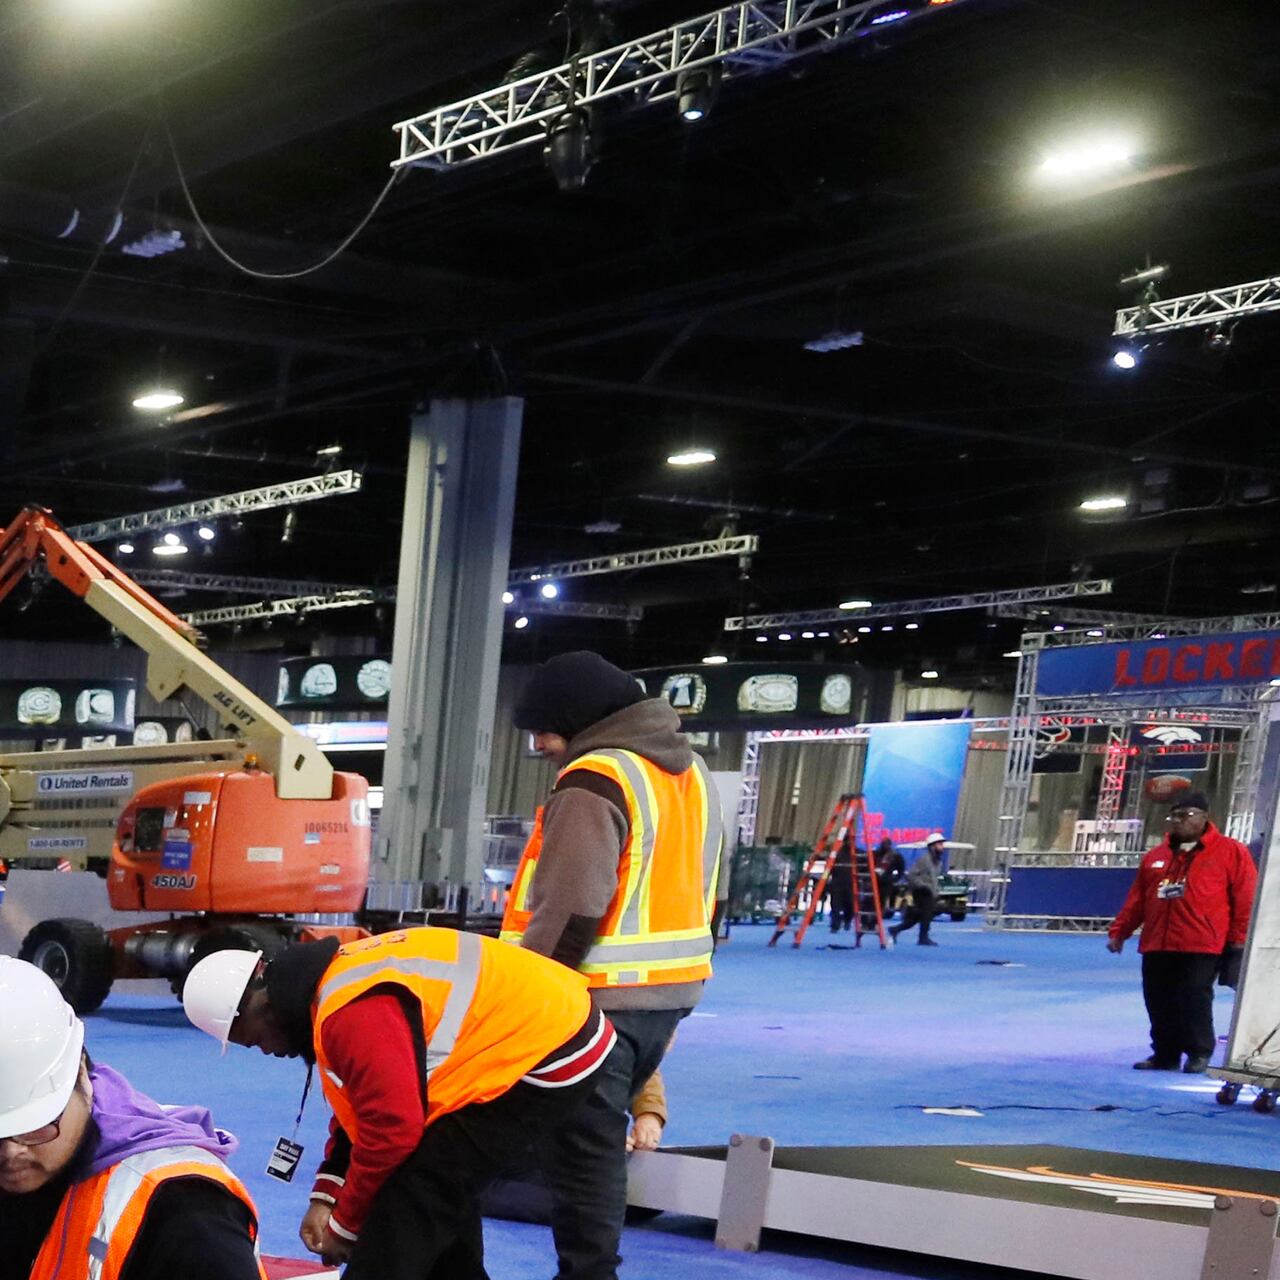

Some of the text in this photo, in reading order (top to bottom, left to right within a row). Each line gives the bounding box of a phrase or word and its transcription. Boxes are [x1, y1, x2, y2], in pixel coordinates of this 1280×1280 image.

[231, 703, 257, 726] LIFT
[54, 774, 129, 790] United Rentals
[151, 874, 197, 890] 450AJ
